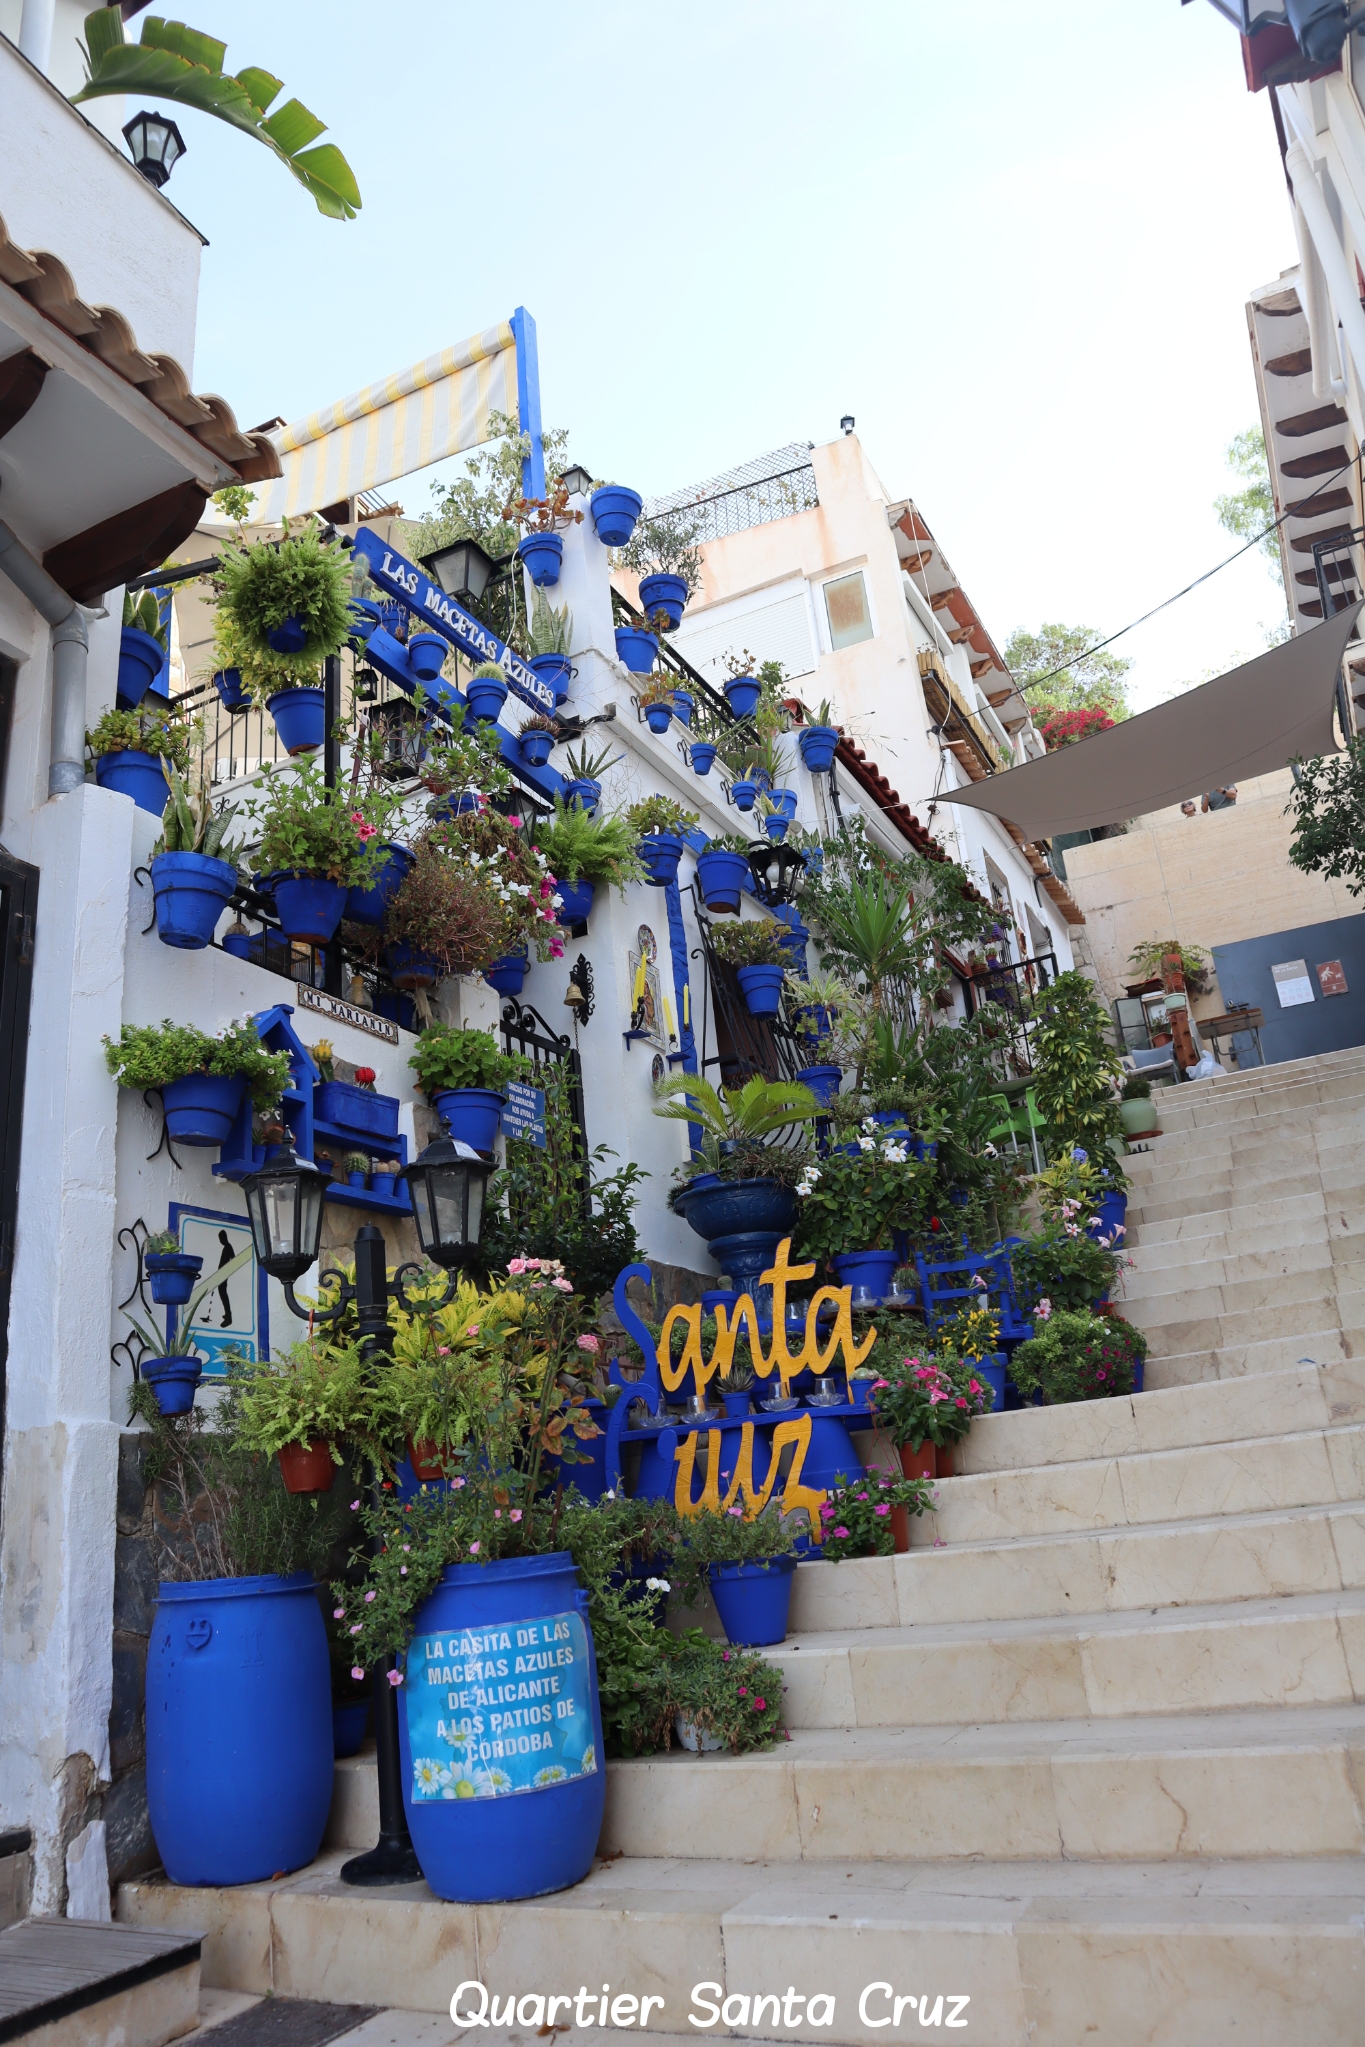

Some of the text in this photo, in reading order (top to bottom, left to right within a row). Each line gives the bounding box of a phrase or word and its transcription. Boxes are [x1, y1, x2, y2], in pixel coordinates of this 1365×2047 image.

[379, 551, 554, 709] LAS MACETAS AZULES
[307, 991, 391, 1036] MI MARIANIN
[508, 1082, 522, 1094] GRACIAS
[531, 1091, 536, 1099] SU
[503, 1113, 521, 1126] MANTENER
[512, 1127, 515, 1135] Y
[520, 1109, 531, 1118] AYUDA
[608, 1236, 878, 1405] Santa
[425, 1621, 571, 1660] LA CASITA DE LAS
[427, 1646, 574, 1686] MACETAS AZULES
[447, 1675, 561, 1710] DE ALICANTE
[436, 1698, 576, 1738] A LOS PATIOS DE
[466, 1730, 554, 1763] CÓRDOBA
